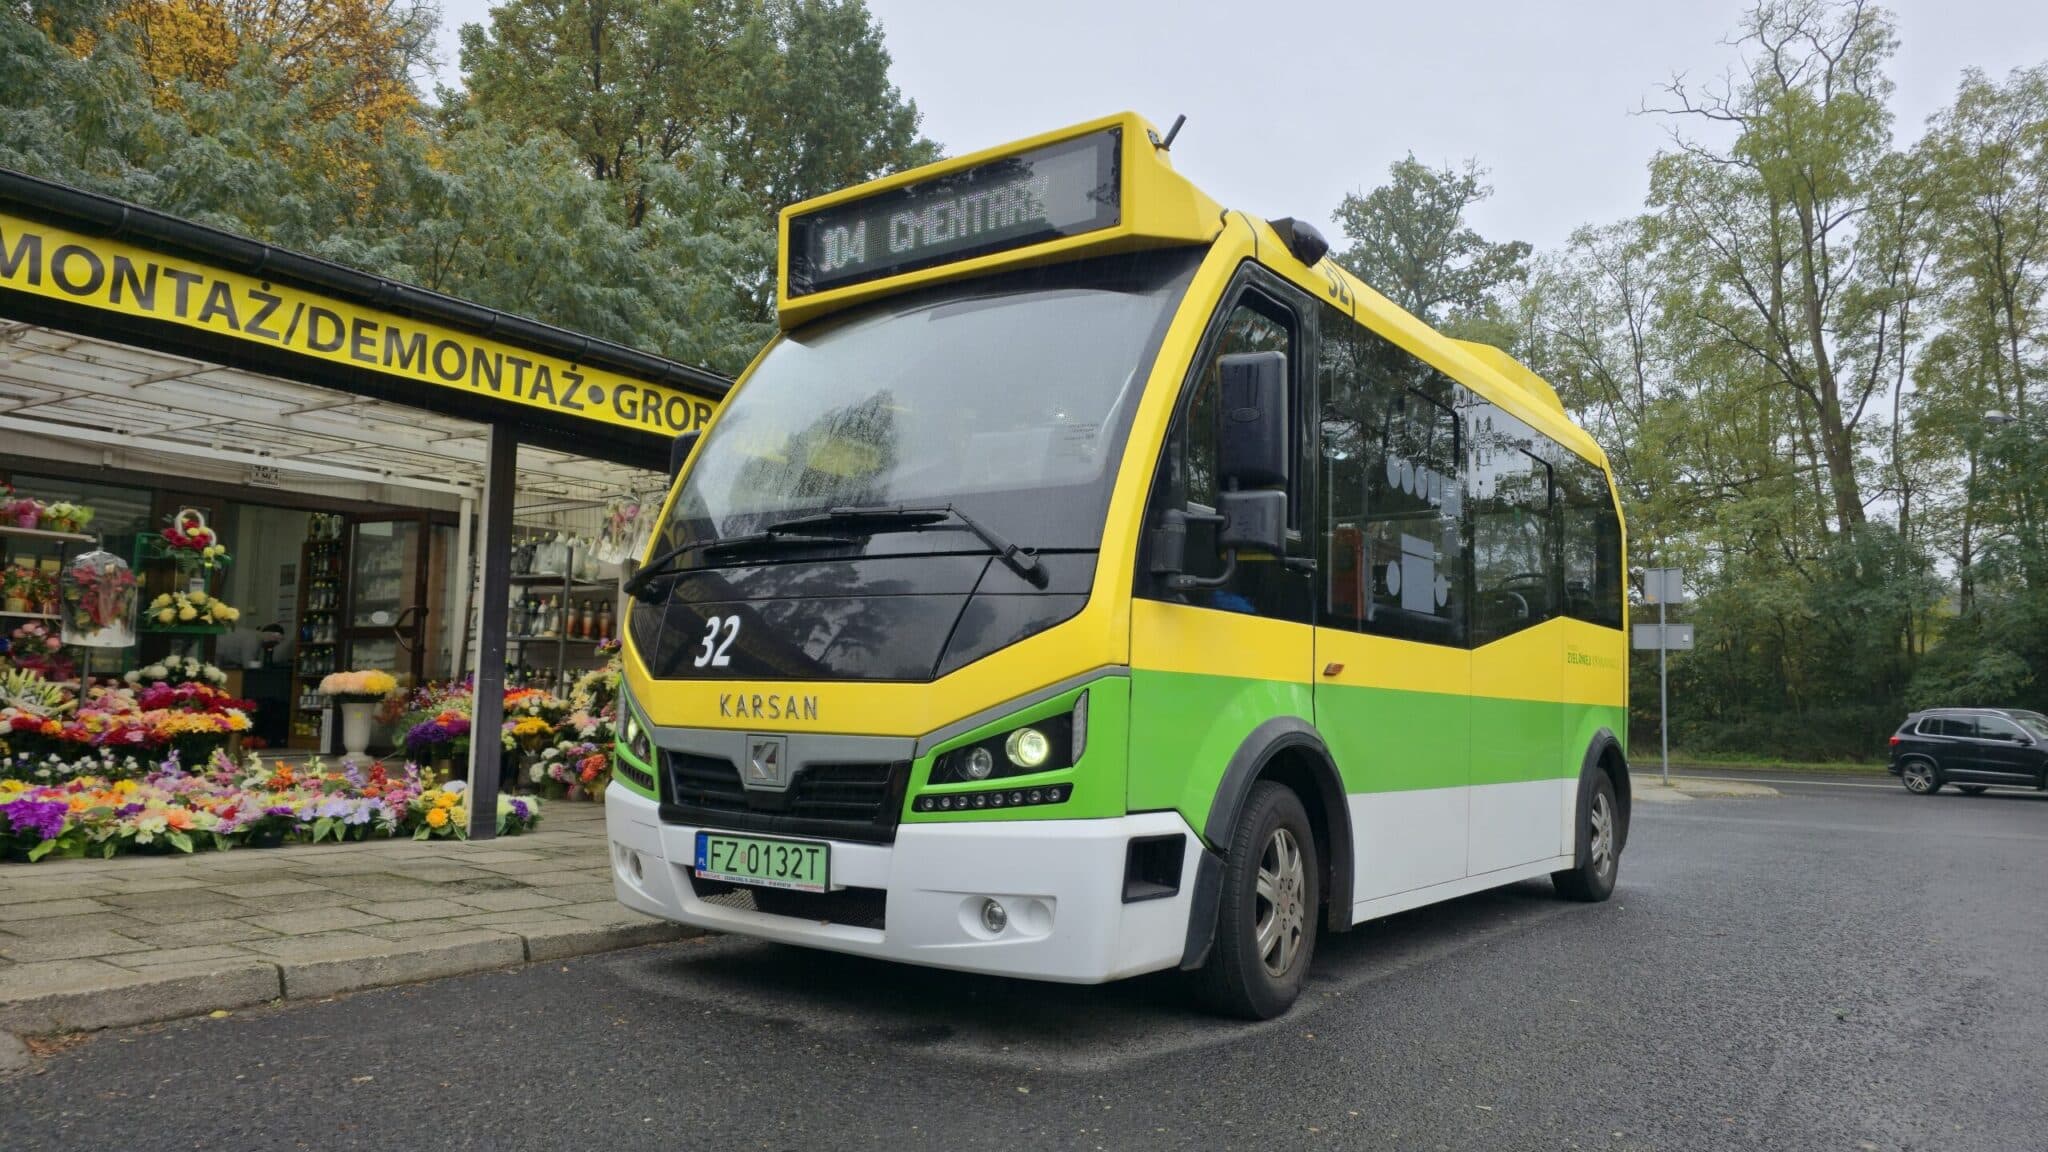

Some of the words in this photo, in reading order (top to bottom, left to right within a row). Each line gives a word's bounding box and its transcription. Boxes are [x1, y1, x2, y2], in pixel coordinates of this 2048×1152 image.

[819, 220, 867, 272] 104
[888, 174, 1049, 253] CMENTARZ
[693, 614, 741, 668] 32
[719, 693, 818, 720] KARSAN
